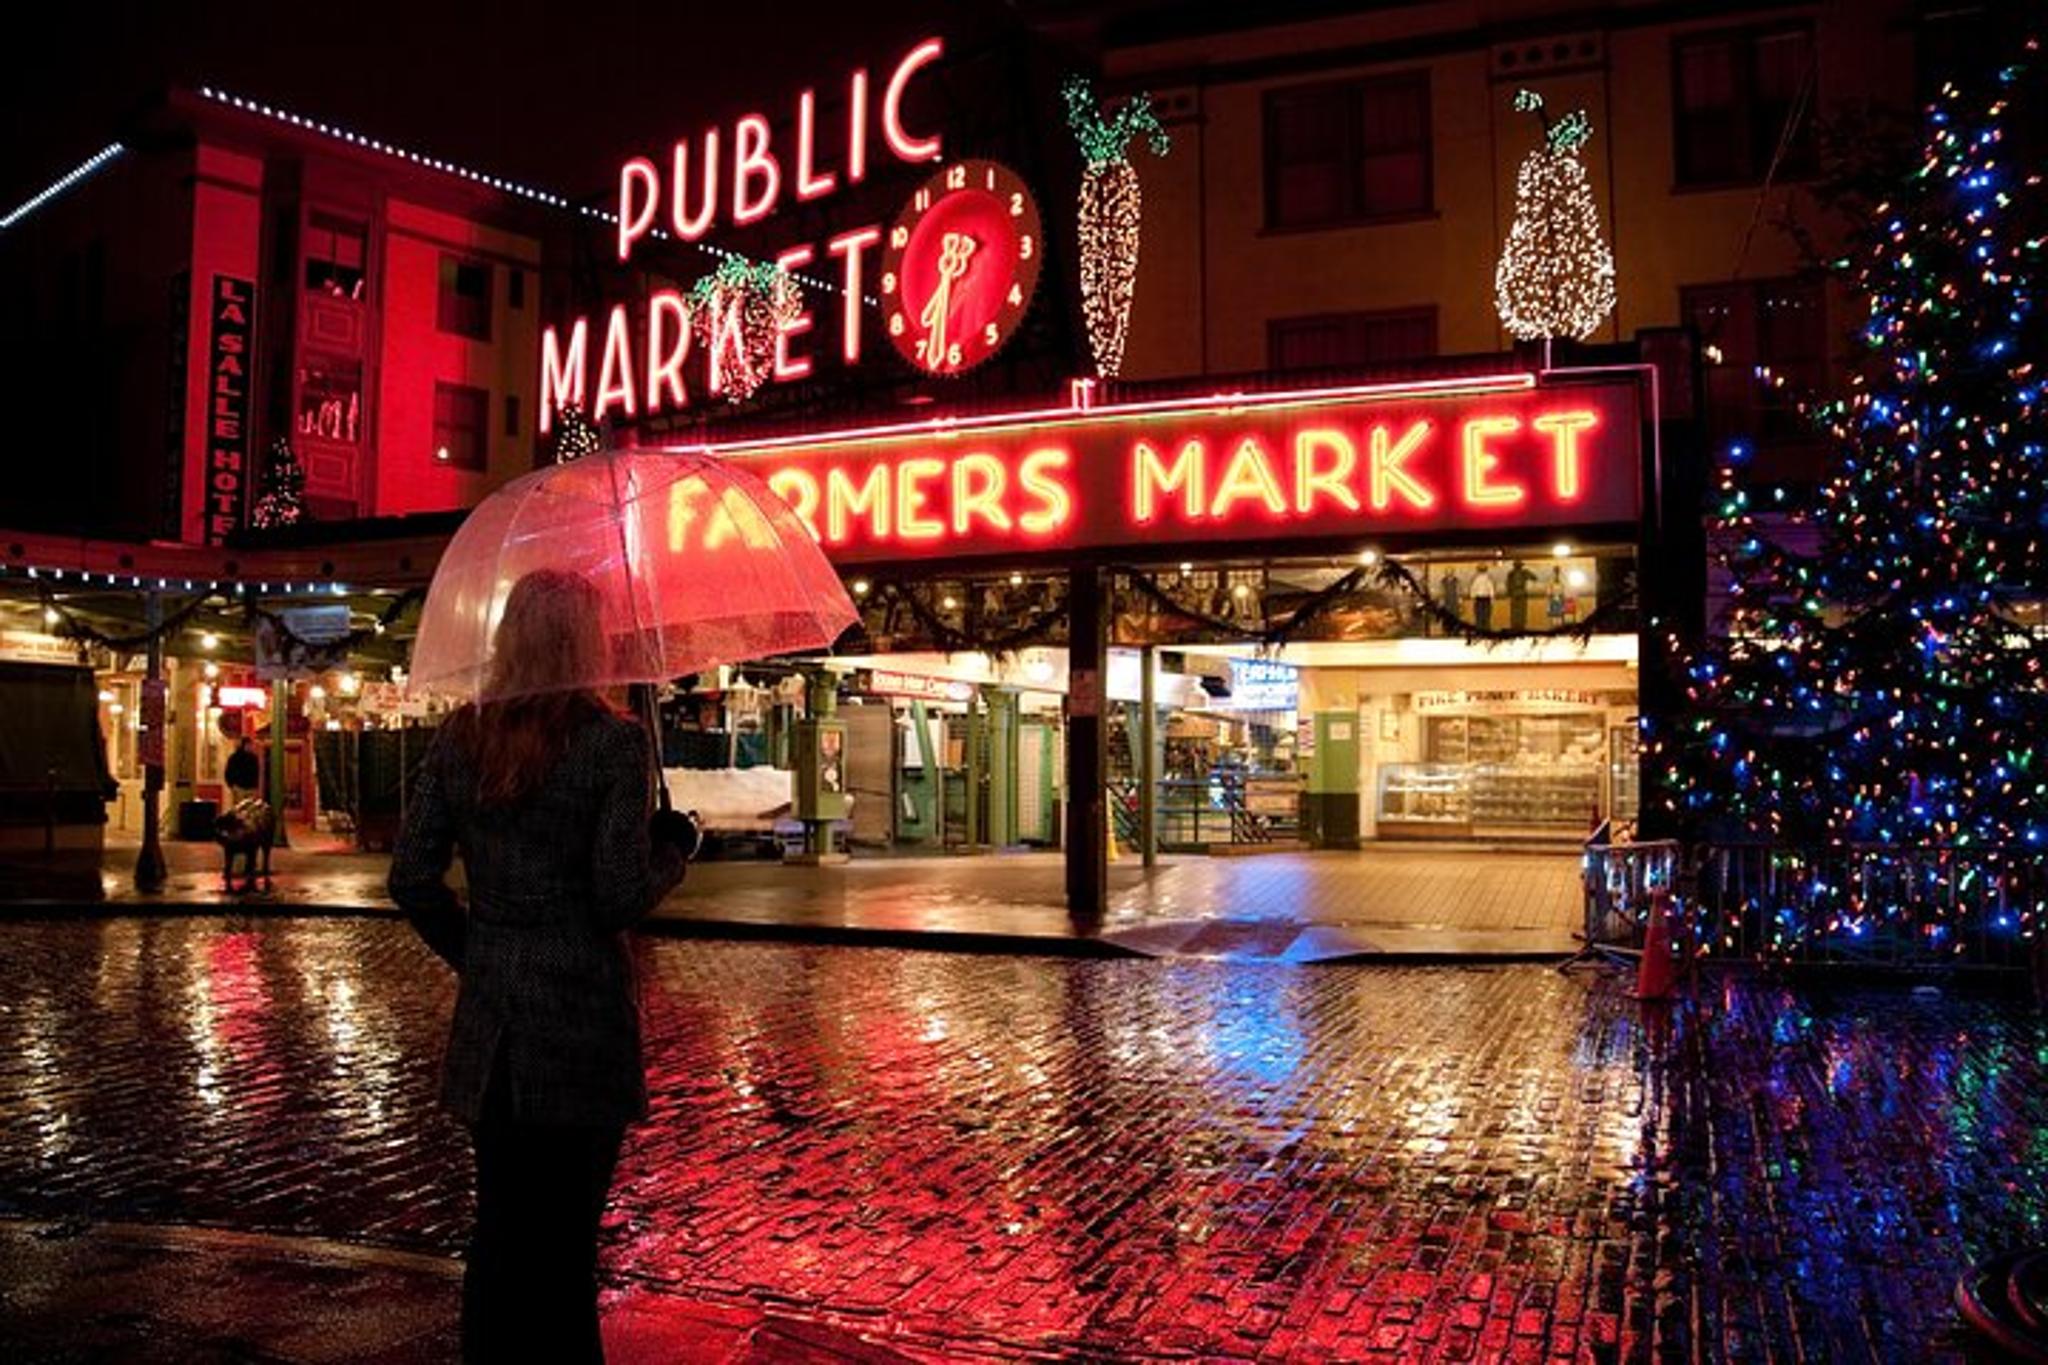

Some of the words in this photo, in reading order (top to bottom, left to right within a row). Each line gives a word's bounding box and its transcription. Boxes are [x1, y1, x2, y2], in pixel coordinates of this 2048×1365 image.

[617, 37, 943, 260] PUBLIC
[947, 165, 966, 189] 12
[914, 187, 930, 212] 11
[1009, 193, 1024, 216] 2
[891, 226, 909, 249] 10
[1019, 235, 1033, 260] 3
[882, 272, 897, 294] 9
[1007, 283, 1023, 306] 4
[219, 280, 246, 325] LA
[538, 225, 881, 434] MARKET
[890, 312, 905, 336] 8
[985, 323, 999, 346] 5
[915, 339, 928, 360] 7
[947, 343, 962, 365] 6
[214, 334, 243, 440] SALLE
[666, 448, 1072, 553] FARMERS
[1132, 410, 1600, 522] MARKET
[211, 450, 241, 545] HOTE
